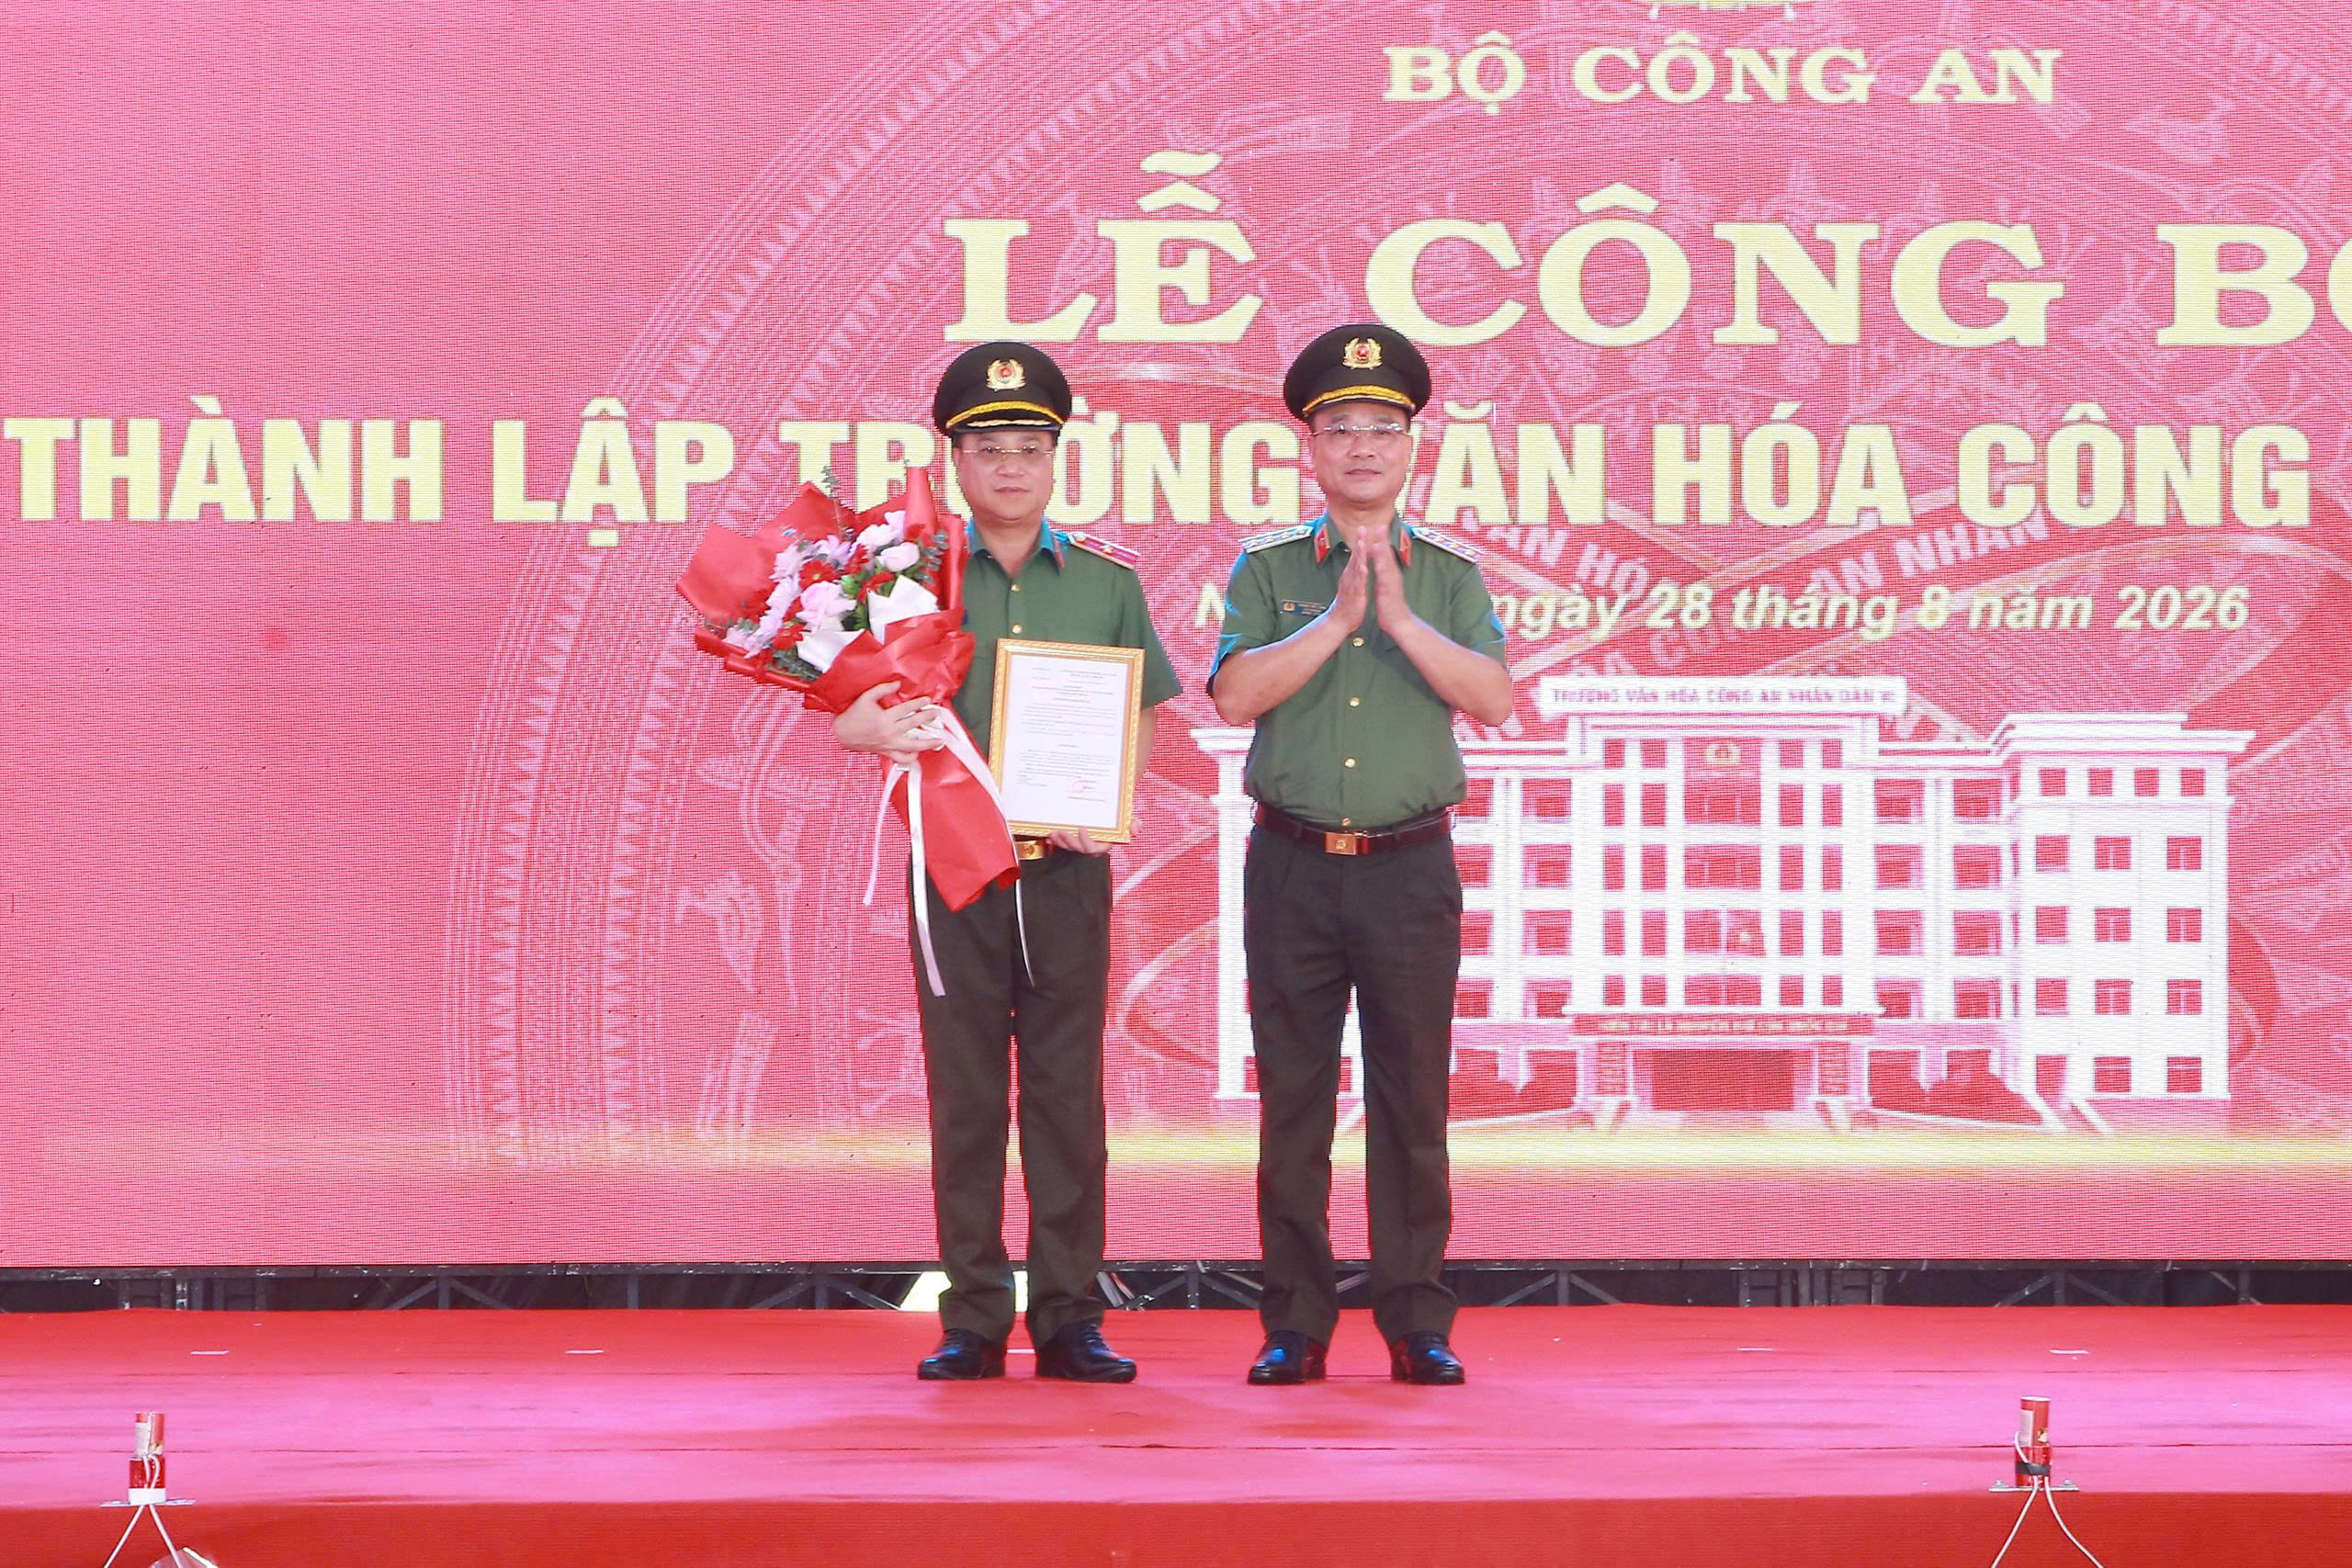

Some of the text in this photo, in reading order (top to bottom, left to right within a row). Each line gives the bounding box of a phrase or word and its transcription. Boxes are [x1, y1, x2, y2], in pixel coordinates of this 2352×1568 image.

[1383, 31, 2063, 115] BỘ CÔNG AN
[944, 151, 2352, 348] LỄ CÔNG B
[3, 395, 445, 522] THÀNH
[492, 397, 735, 547] LẬP
[1394, 400, 1607, 525] ĂN
[1652, 401, 1913, 526] HÓA
[1958, 401, 2311, 527] CÔNG
[1489, 583, 2252, 640] ngày 28 tháng 8 năm 2026
